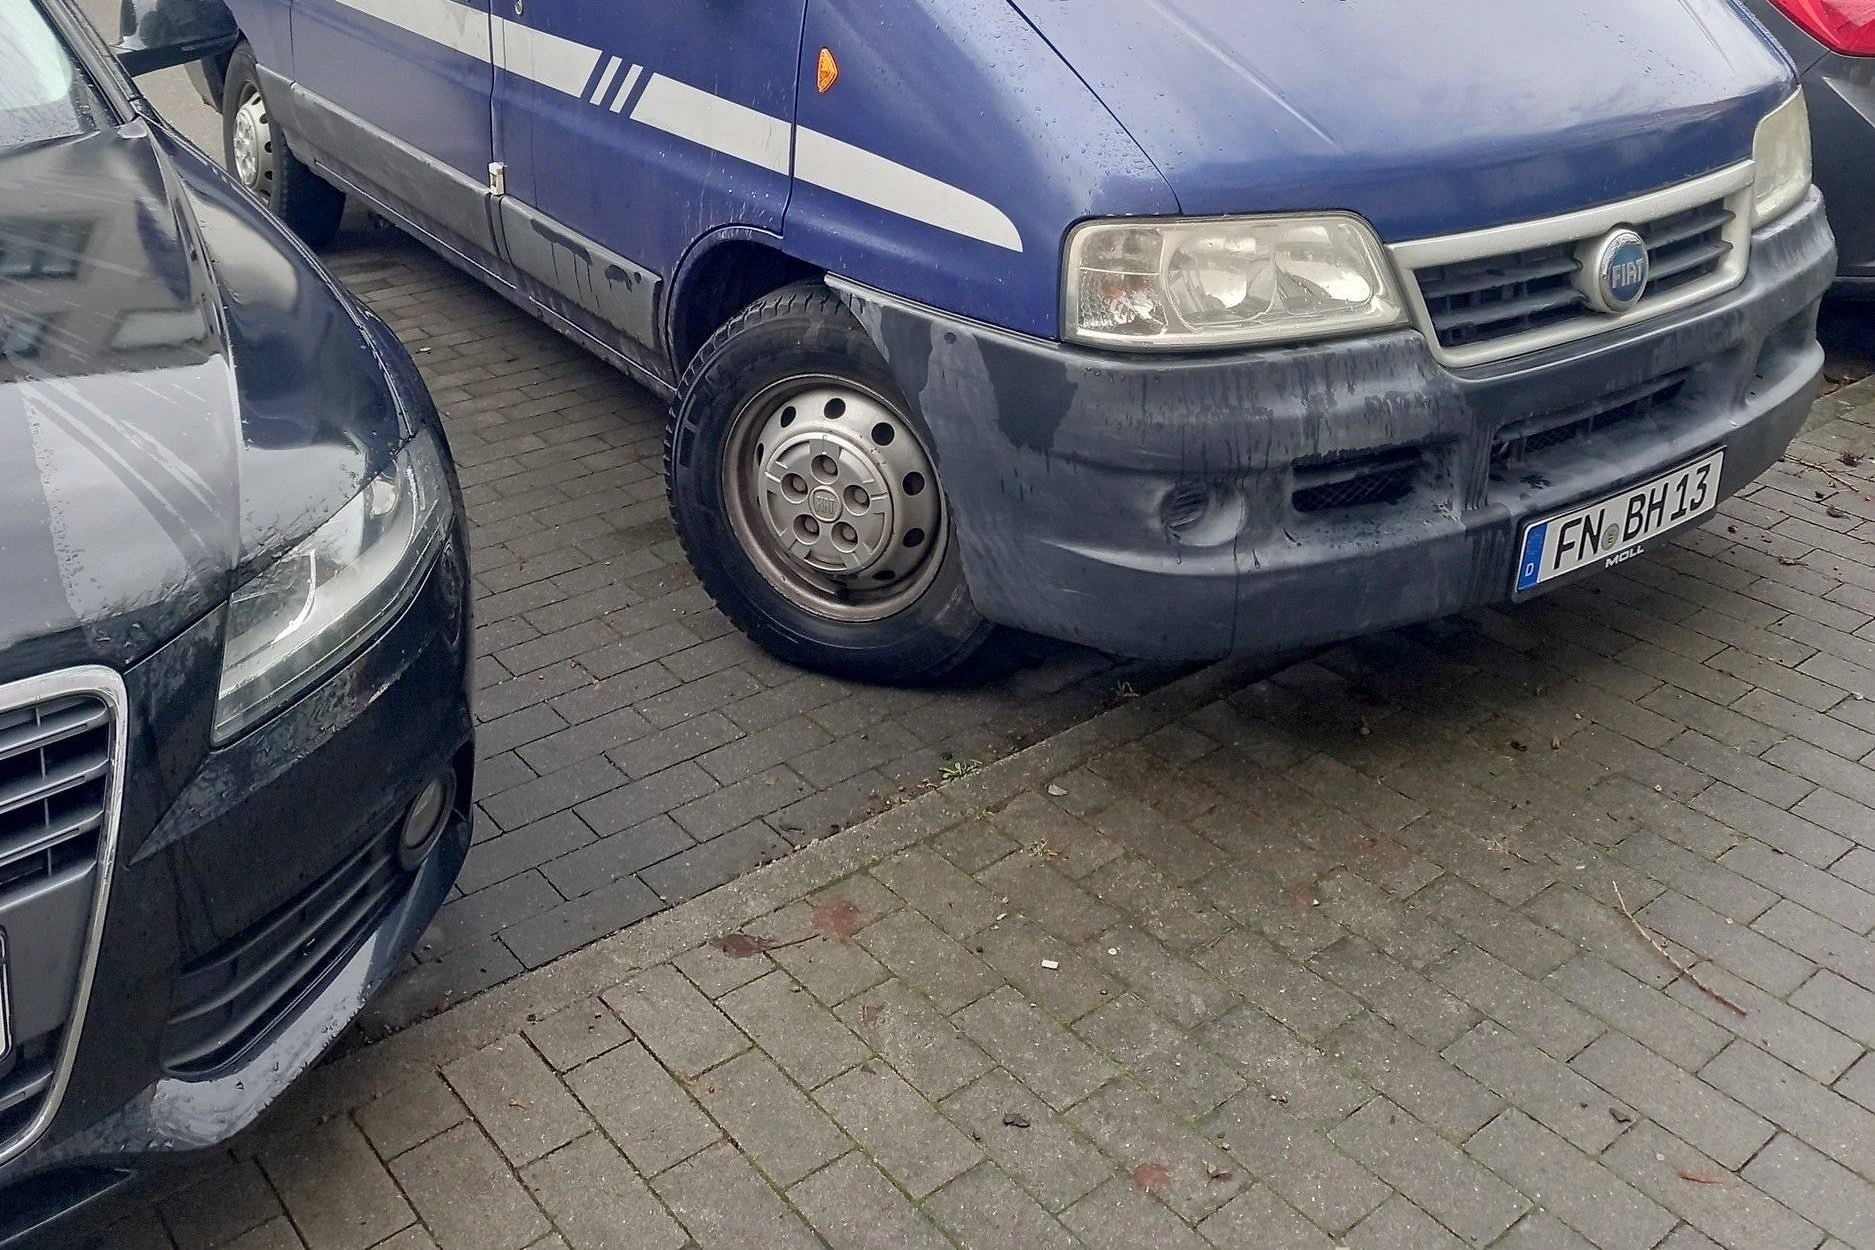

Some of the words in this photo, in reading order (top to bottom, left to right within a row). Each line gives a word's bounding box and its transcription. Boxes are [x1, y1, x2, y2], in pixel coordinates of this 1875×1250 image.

[1611, 258, 1645, 289] FIAT
[1553, 507, 1606, 570] FN
[1622, 482, 1669, 543] BH
[1670, 463, 1712, 522] 13
[1524, 562, 1534, 577] D
[1604, 545, 1645, 568] MOLL
